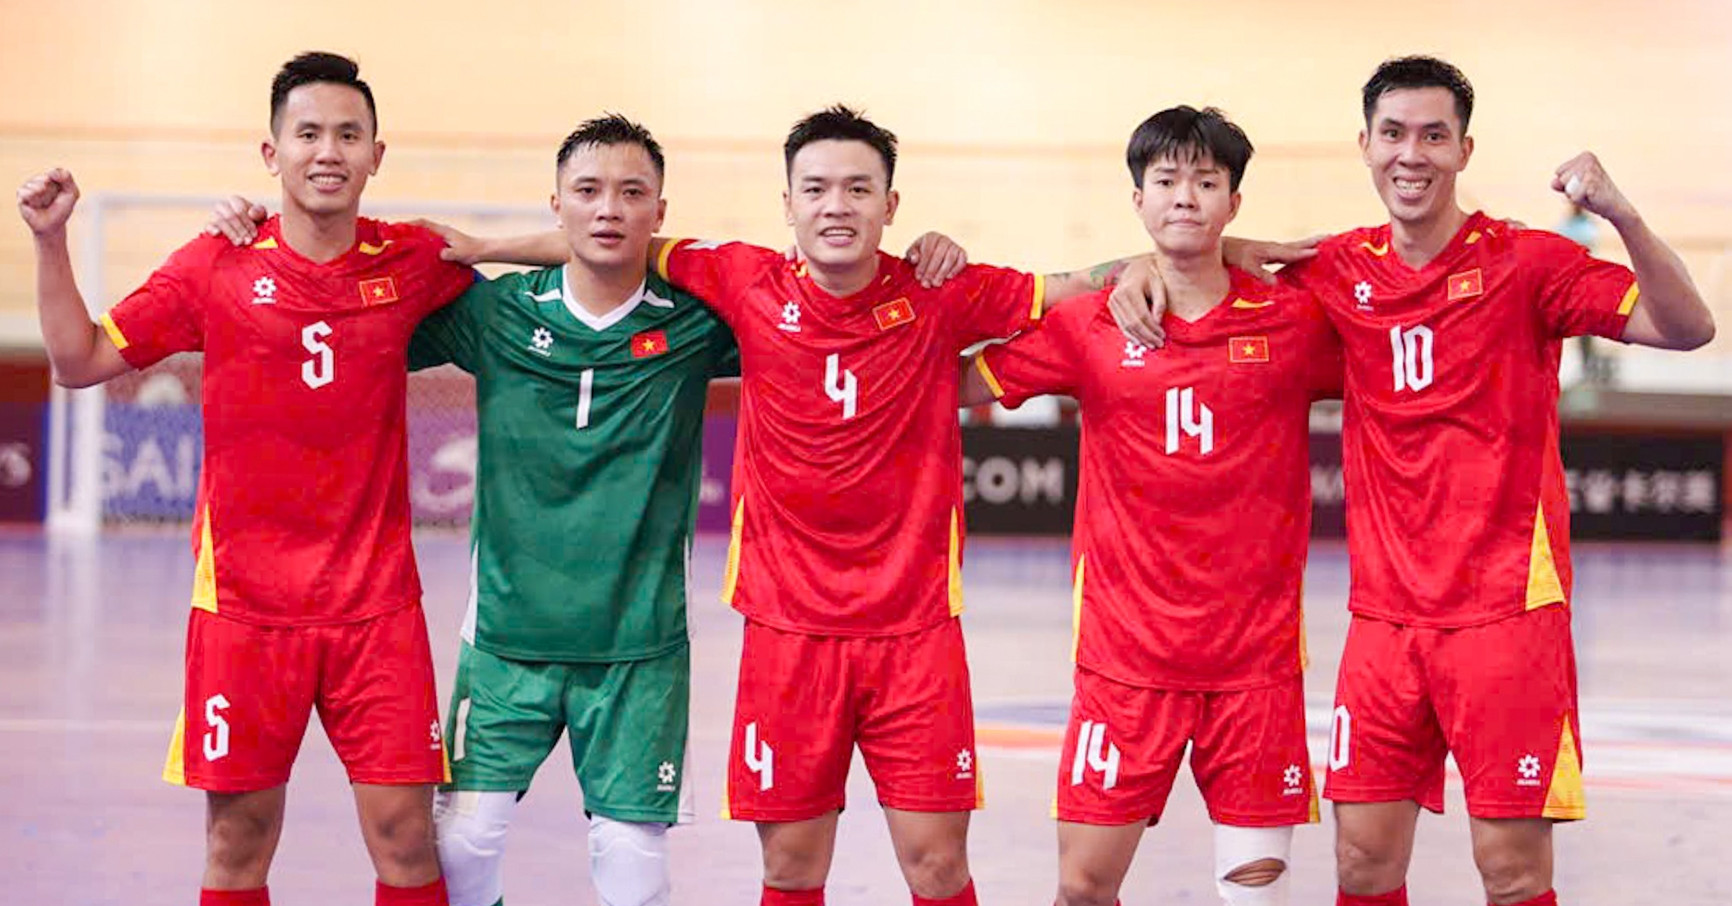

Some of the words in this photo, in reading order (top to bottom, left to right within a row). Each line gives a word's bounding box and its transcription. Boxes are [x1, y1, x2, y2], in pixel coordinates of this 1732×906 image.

[301, 321, 334, 389] 5
[824, 353, 857, 420] 4
[1390, 325, 1433, 392] 10
[576, 369, 594, 429] 1
[1165, 387, 1213, 455] 14
[203, 694, 230, 761] 5
[453, 697, 472, 761] 1
[744, 722, 773, 791] 4
[1071, 719, 1121, 790] 14
